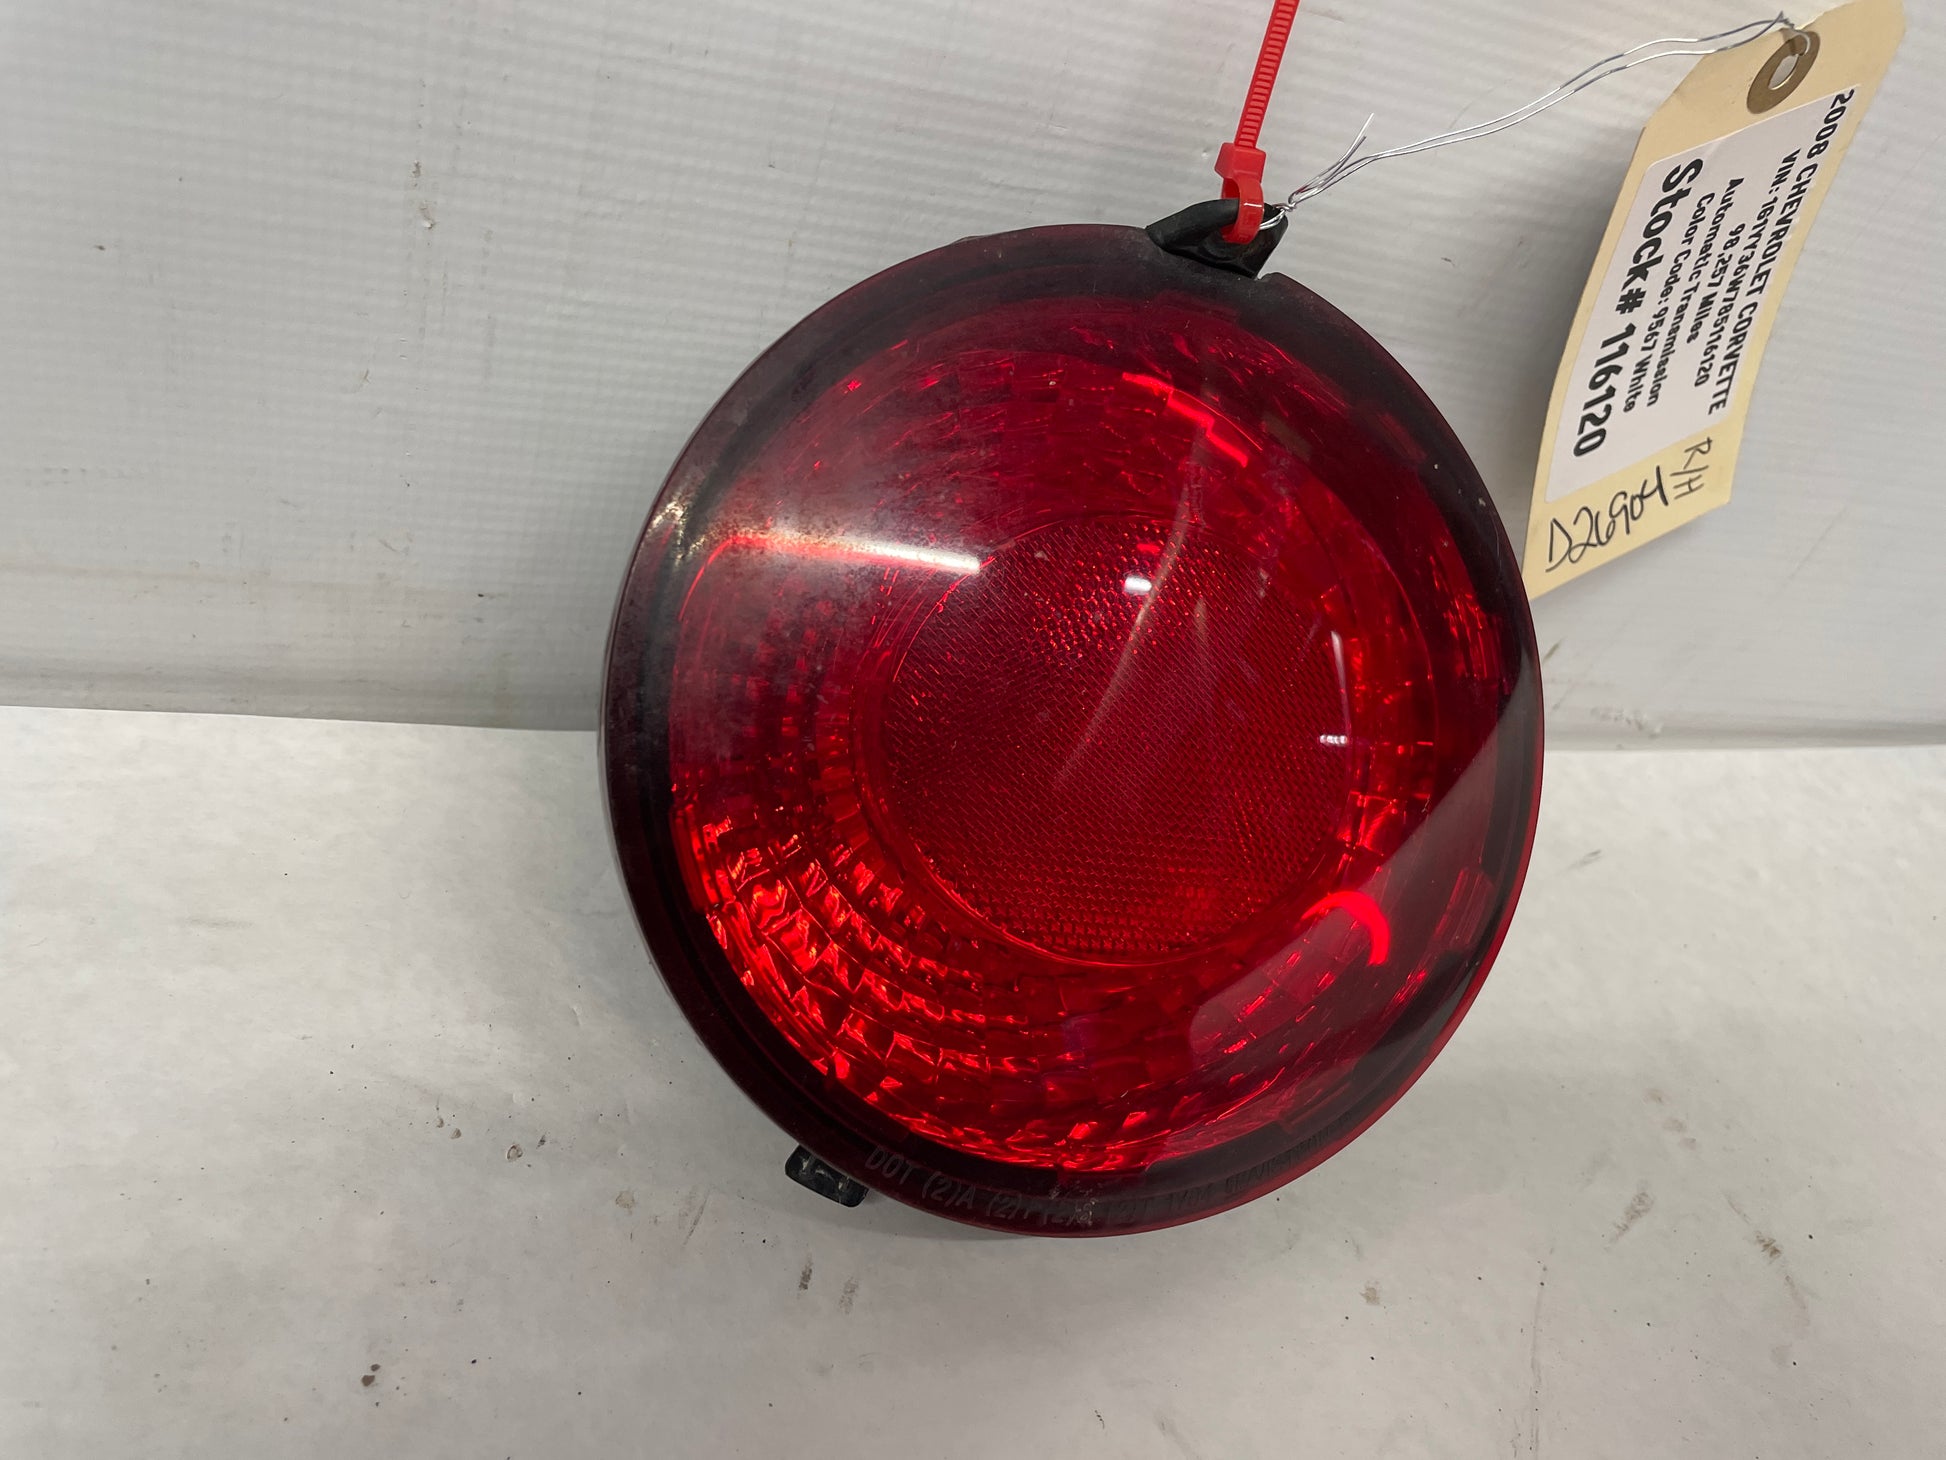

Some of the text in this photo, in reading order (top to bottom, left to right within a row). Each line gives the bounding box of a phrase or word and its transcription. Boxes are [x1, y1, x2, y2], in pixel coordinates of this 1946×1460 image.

[1769, 148, 1801, 194] VIN:
[1573, 159, 1703, 457] Stock# 116120
[1623, 192, 1715, 412] Color Code: 9567 White
[1647, 178, 1744, 407] Automatic Transmission
[1687, 223, 1745, 344] 98,257 Miles
[1708, 89, 1855, 415] 2008 CHEVROLET CORVETTE
[1545, 465, 1668, 573] D26904
[1670, 437, 1712, 500] R/H
[865, 1145, 917, 1184] DOT
[920, 1170, 977, 1209] (2)A
